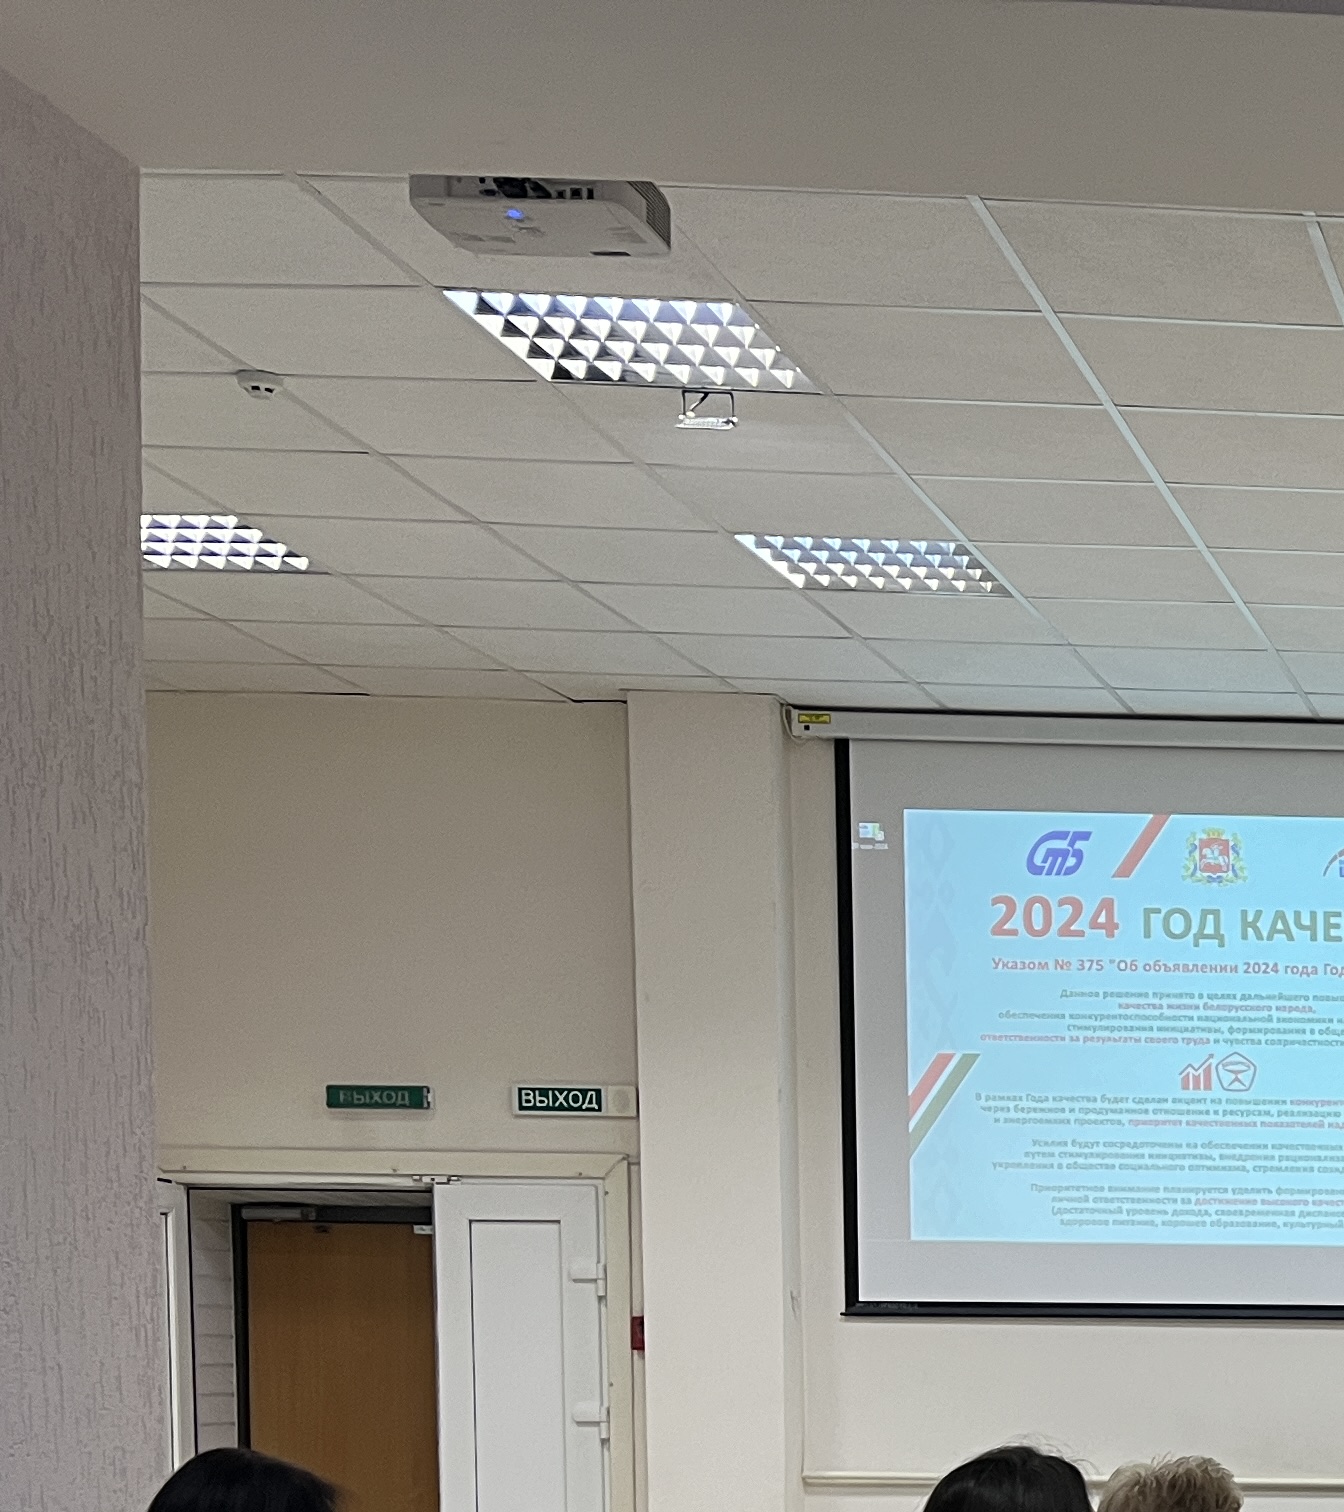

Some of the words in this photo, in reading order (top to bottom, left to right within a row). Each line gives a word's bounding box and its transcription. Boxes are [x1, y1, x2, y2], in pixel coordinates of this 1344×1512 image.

[990, 895, 1119, 938] 2024
[1142, 907, 1225, 947] ГОД
[991, 958, 1050, 972] Указом
[1053, 959, 1072, 972] №
[1077, 959, 1104, 973] 375
[1109, 960, 1139, 973] "Об
[1142, 960, 1239, 975] объявлении
[1243, 962, 1280, 975] 2024
[1283, 965, 1319, 978] года
[521, 1089, 598, 1109] ВЫХОД
